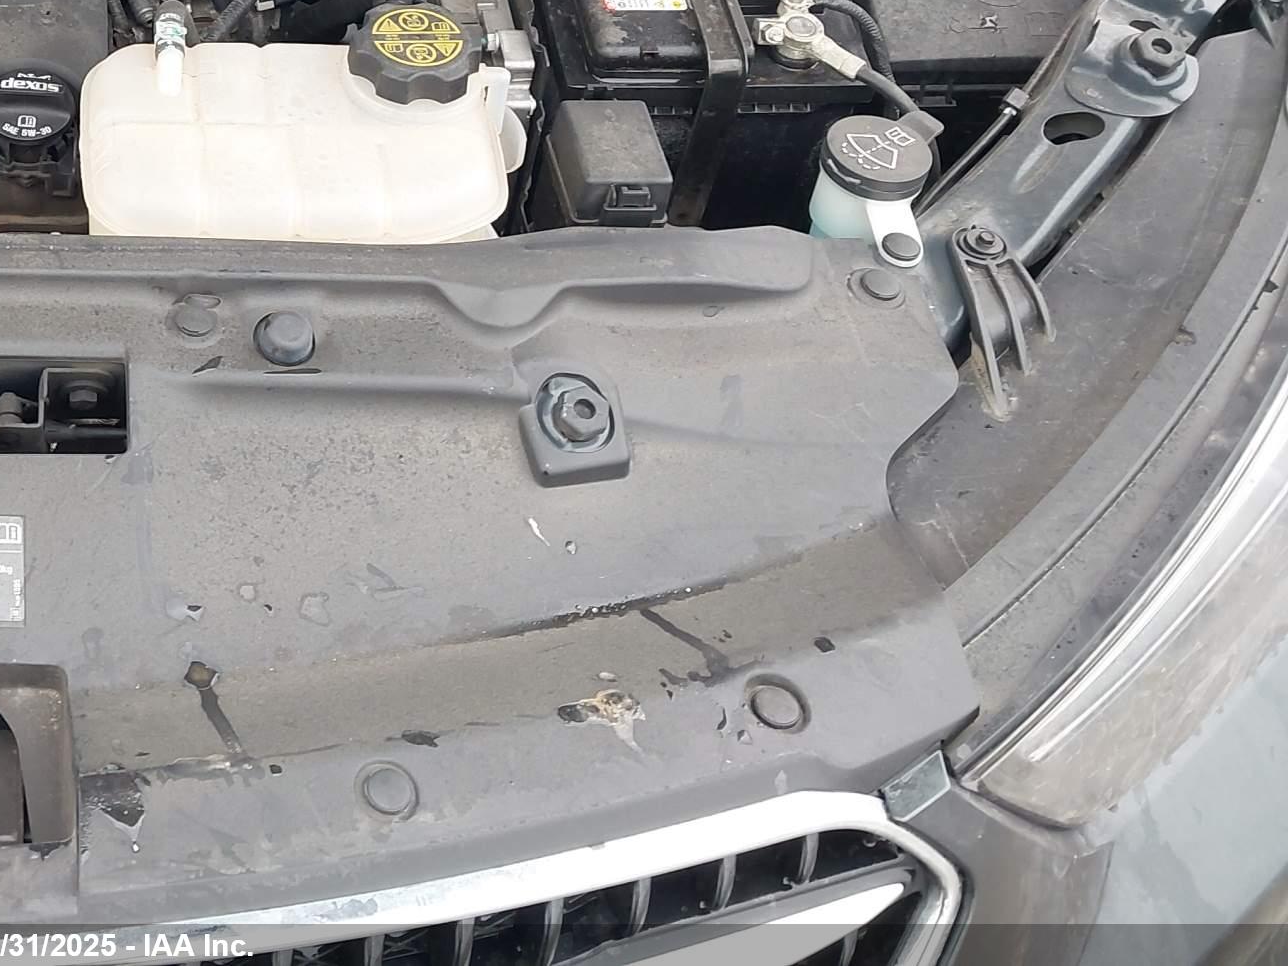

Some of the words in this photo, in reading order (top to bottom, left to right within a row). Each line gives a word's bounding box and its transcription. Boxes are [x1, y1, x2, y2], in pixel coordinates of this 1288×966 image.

[0, 77, 60, 93] dexos
[1, 122, 20, 136] SAE
[21, 125, 52, 137] 5W-30
